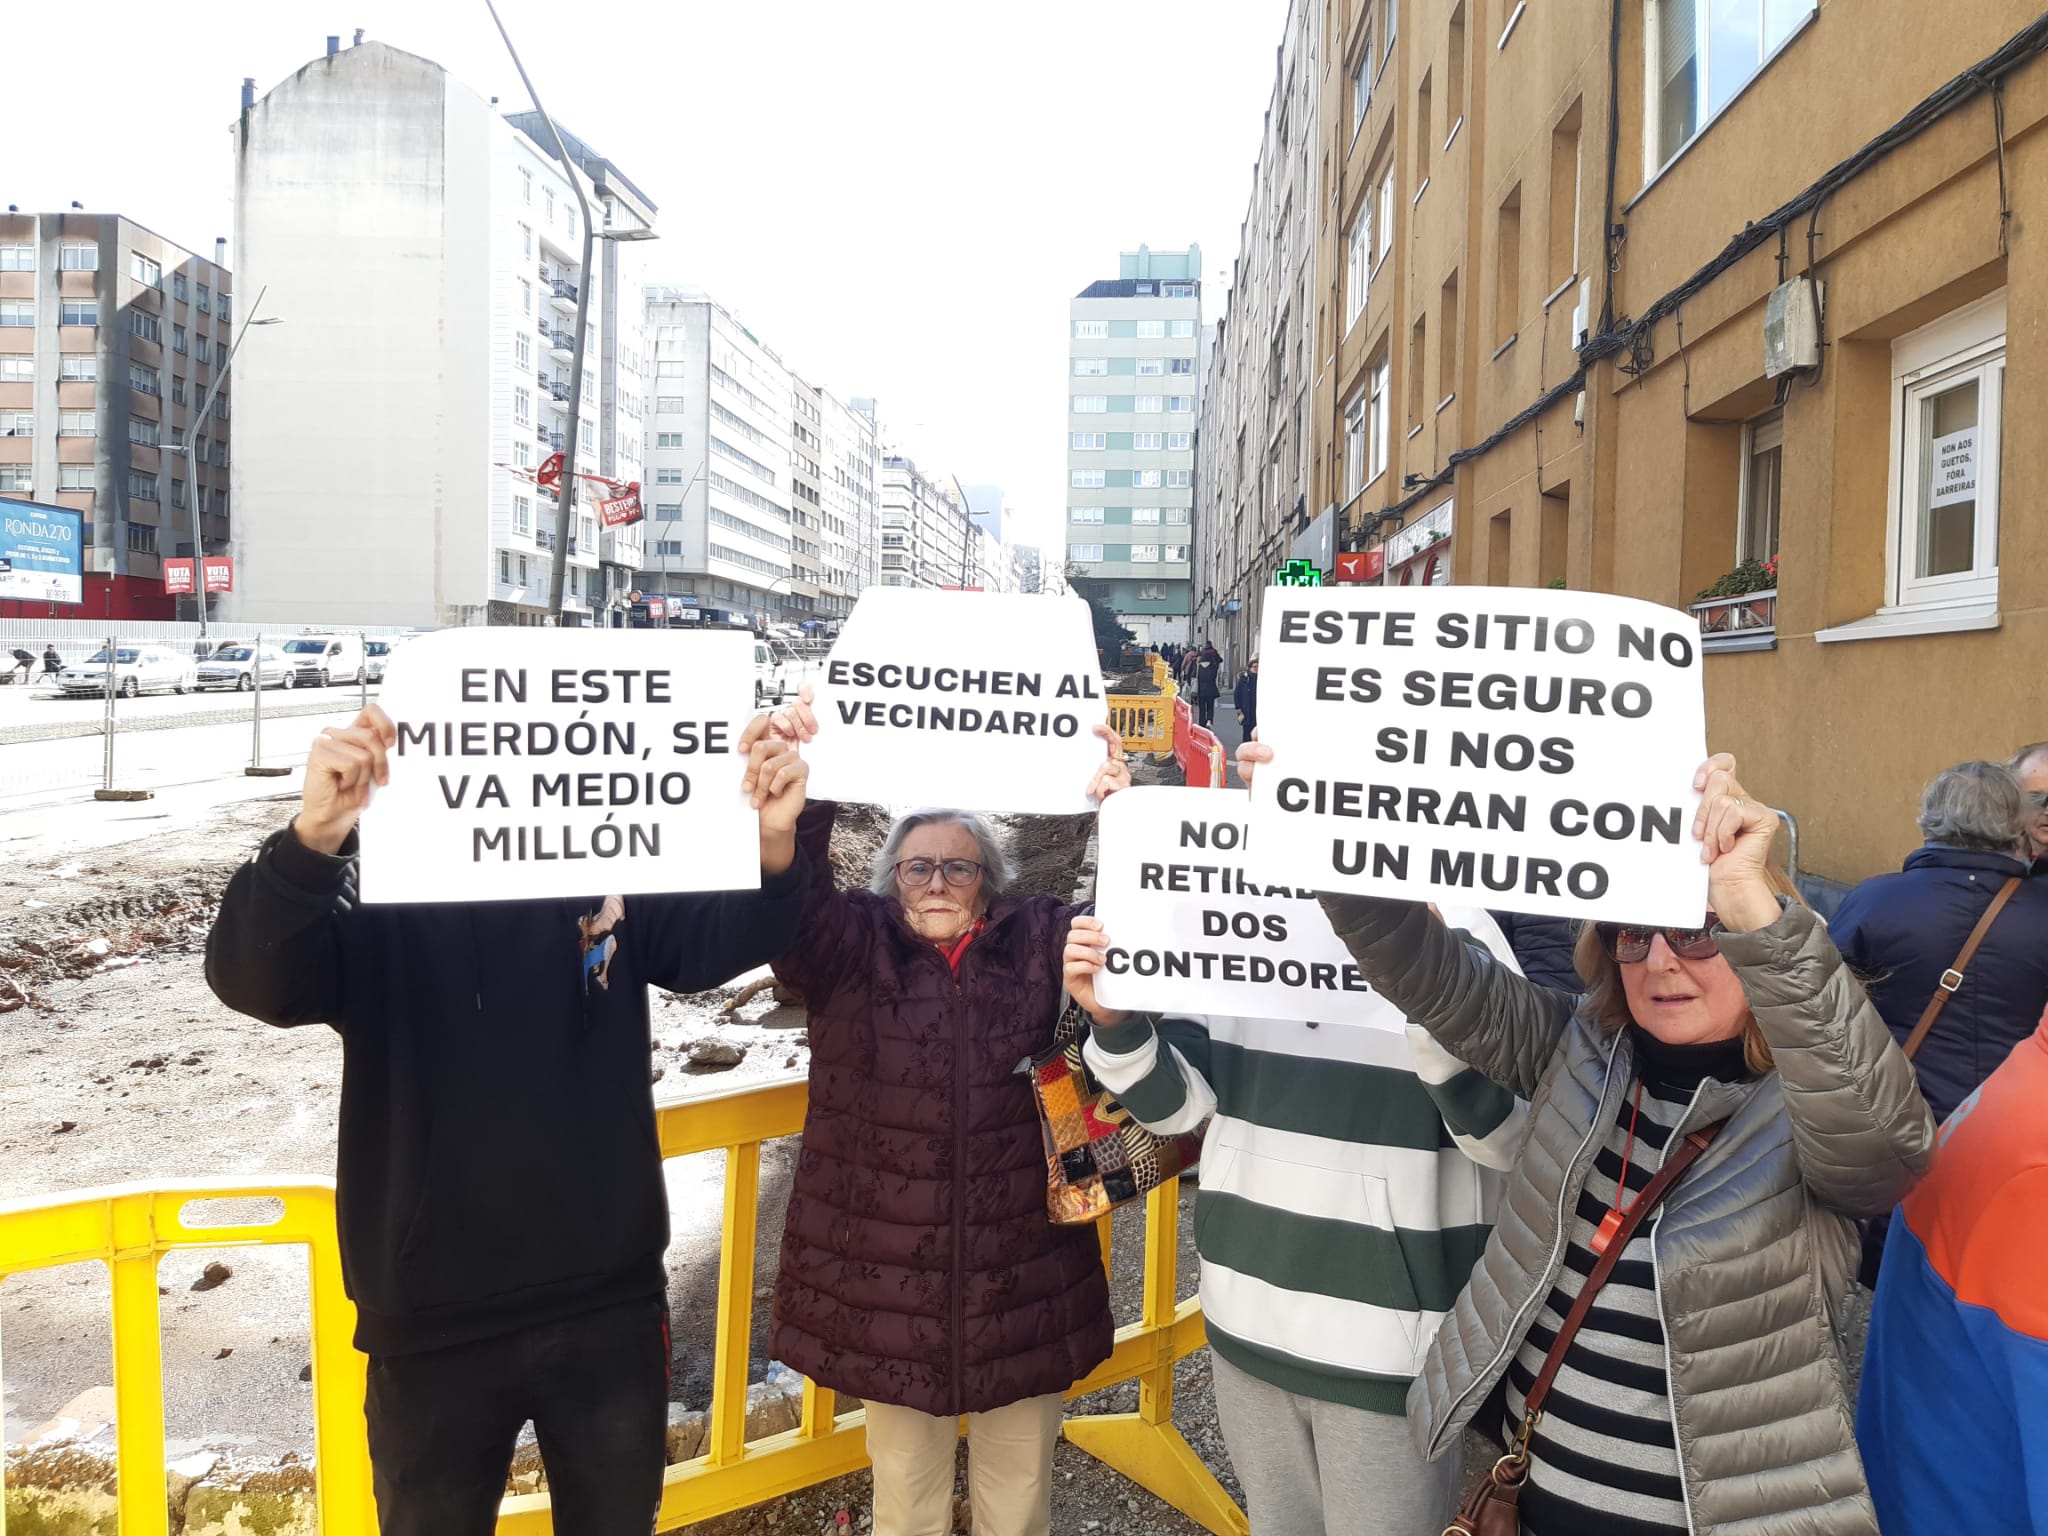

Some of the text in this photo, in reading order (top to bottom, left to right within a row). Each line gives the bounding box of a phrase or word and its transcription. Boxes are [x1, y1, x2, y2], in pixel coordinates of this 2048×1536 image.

[1941, 454, 1971, 468] GUETOS,
[1943, 439, 1972, 455] NON AOS
[1937, 481, 1976, 496] BARREIRAS
[1280, 611, 1692, 668] ESTE SITIO NO
[462, 669, 671, 704] EN ESTE
[829, 661, 1098, 699] ESCUCHEN AL
[1316, 667, 1651, 719] ES SEGURO
[397, 711, 729, 761] MIERDÓN, SE
[837, 701, 1079, 738] VECINDARIO
[1376, 727, 1574, 775] SI NOS
[439, 772, 691, 809] VA MEDIO
[1277, 778, 1682, 845] CIERRAN CON
[474, 812, 660, 862] MILLÓN
[1180, 822, 1248, 851] NO
[1333, 839, 1609, 900] UN MURO
[1203, 911, 1288, 942] DOS
